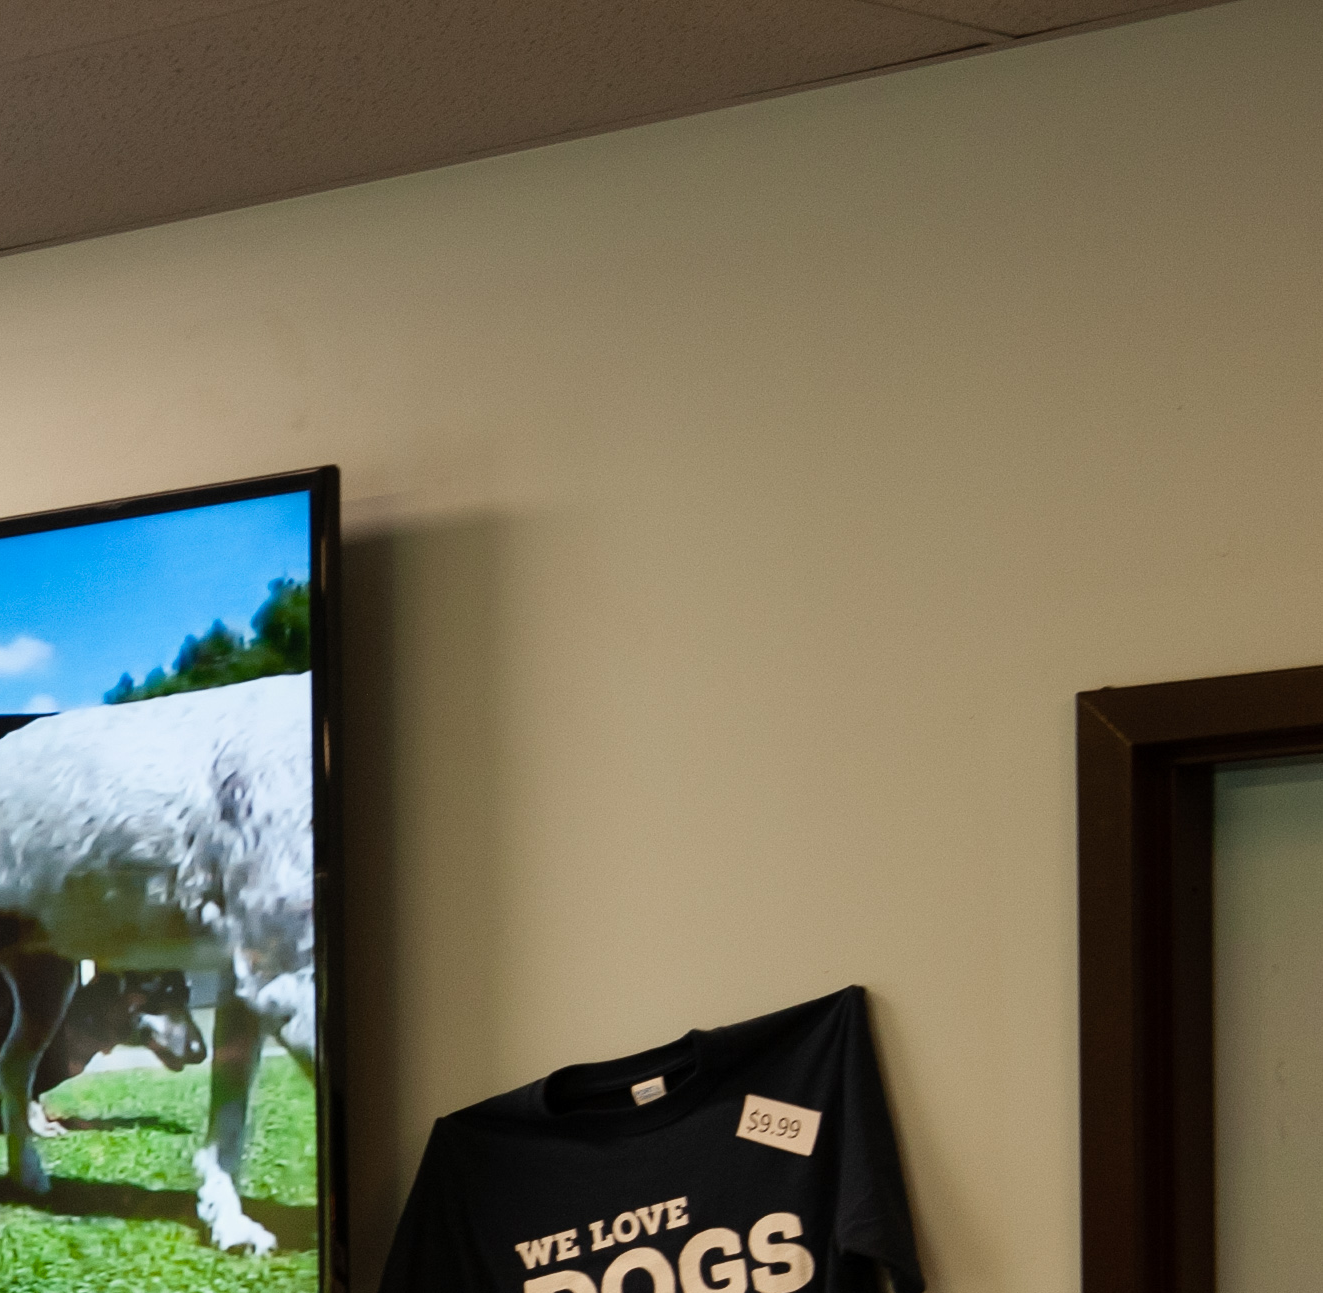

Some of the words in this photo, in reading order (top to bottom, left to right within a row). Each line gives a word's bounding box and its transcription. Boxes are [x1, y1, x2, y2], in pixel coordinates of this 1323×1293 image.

[746, 1108, 802, 1139] $9.99
[514, 1229, 580, 1270] WE
[588, 1196, 690, 1252] LOVE
